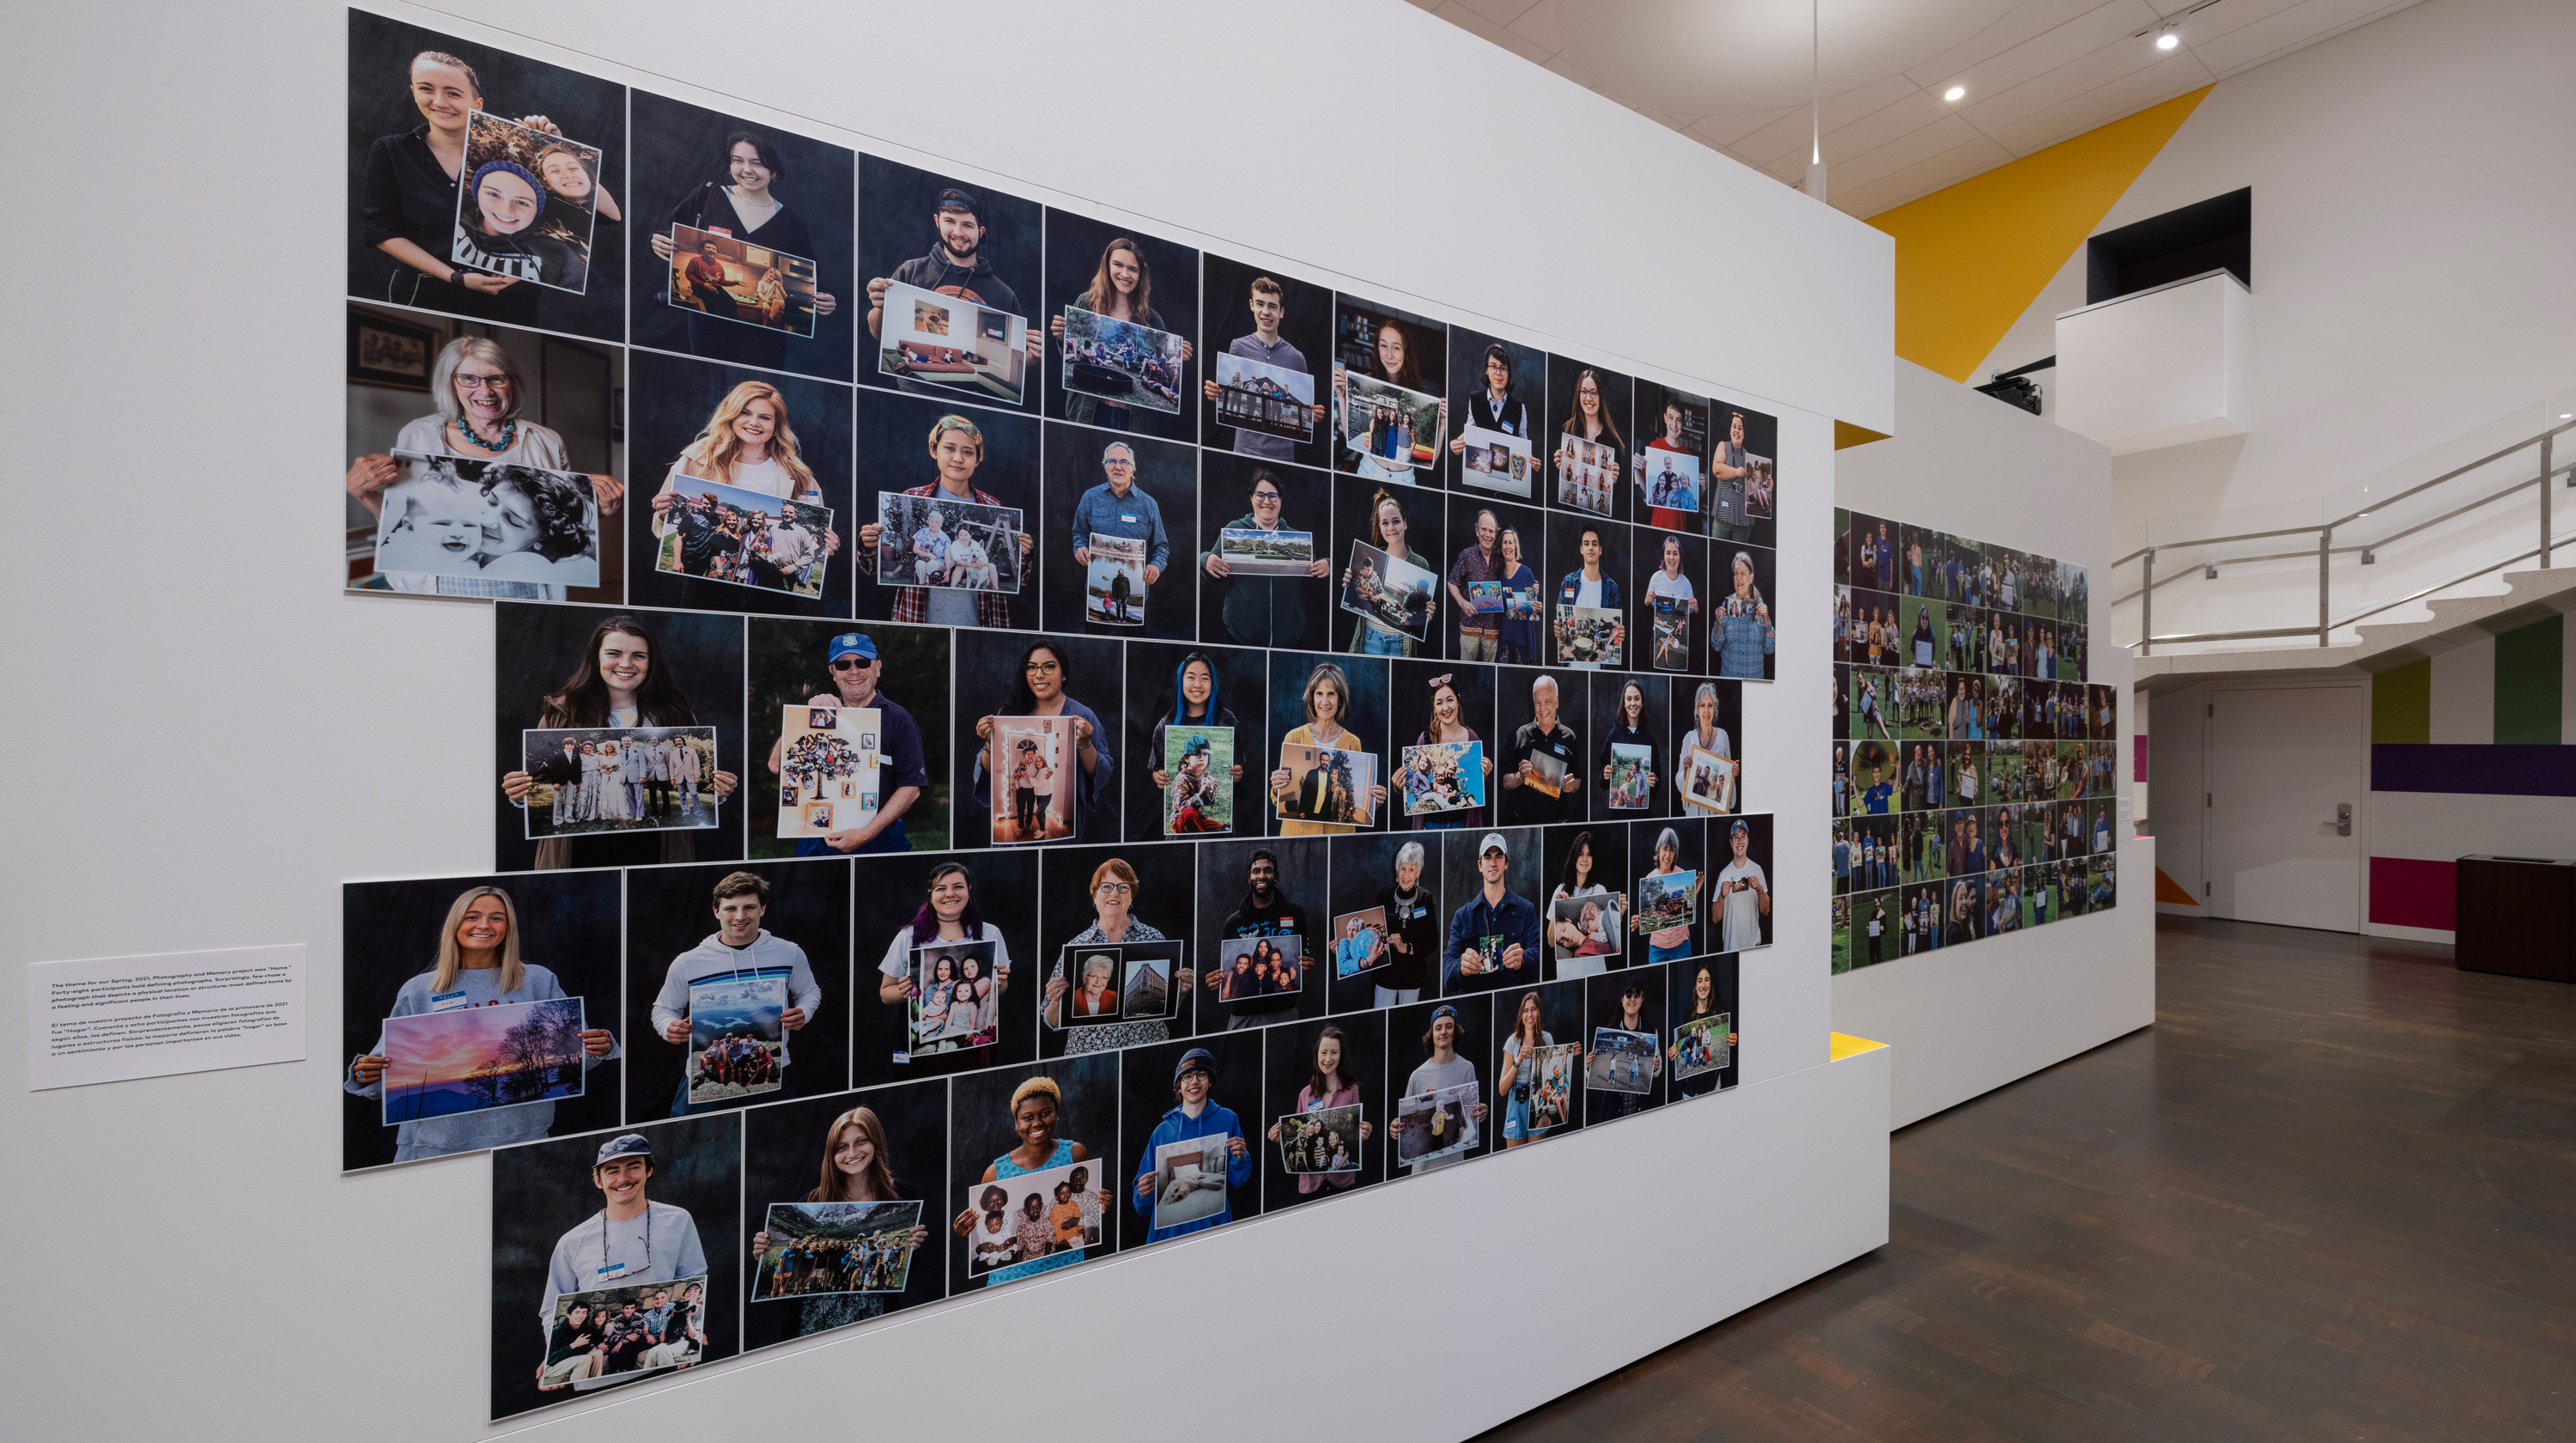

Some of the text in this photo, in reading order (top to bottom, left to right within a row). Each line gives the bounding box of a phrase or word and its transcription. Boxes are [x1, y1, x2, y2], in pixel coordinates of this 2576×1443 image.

[173, 977, 213, 986] photographs.
[51, 995, 90, 1003] photograph
[128, 1025, 191, 1034] Sorprendentemente,
